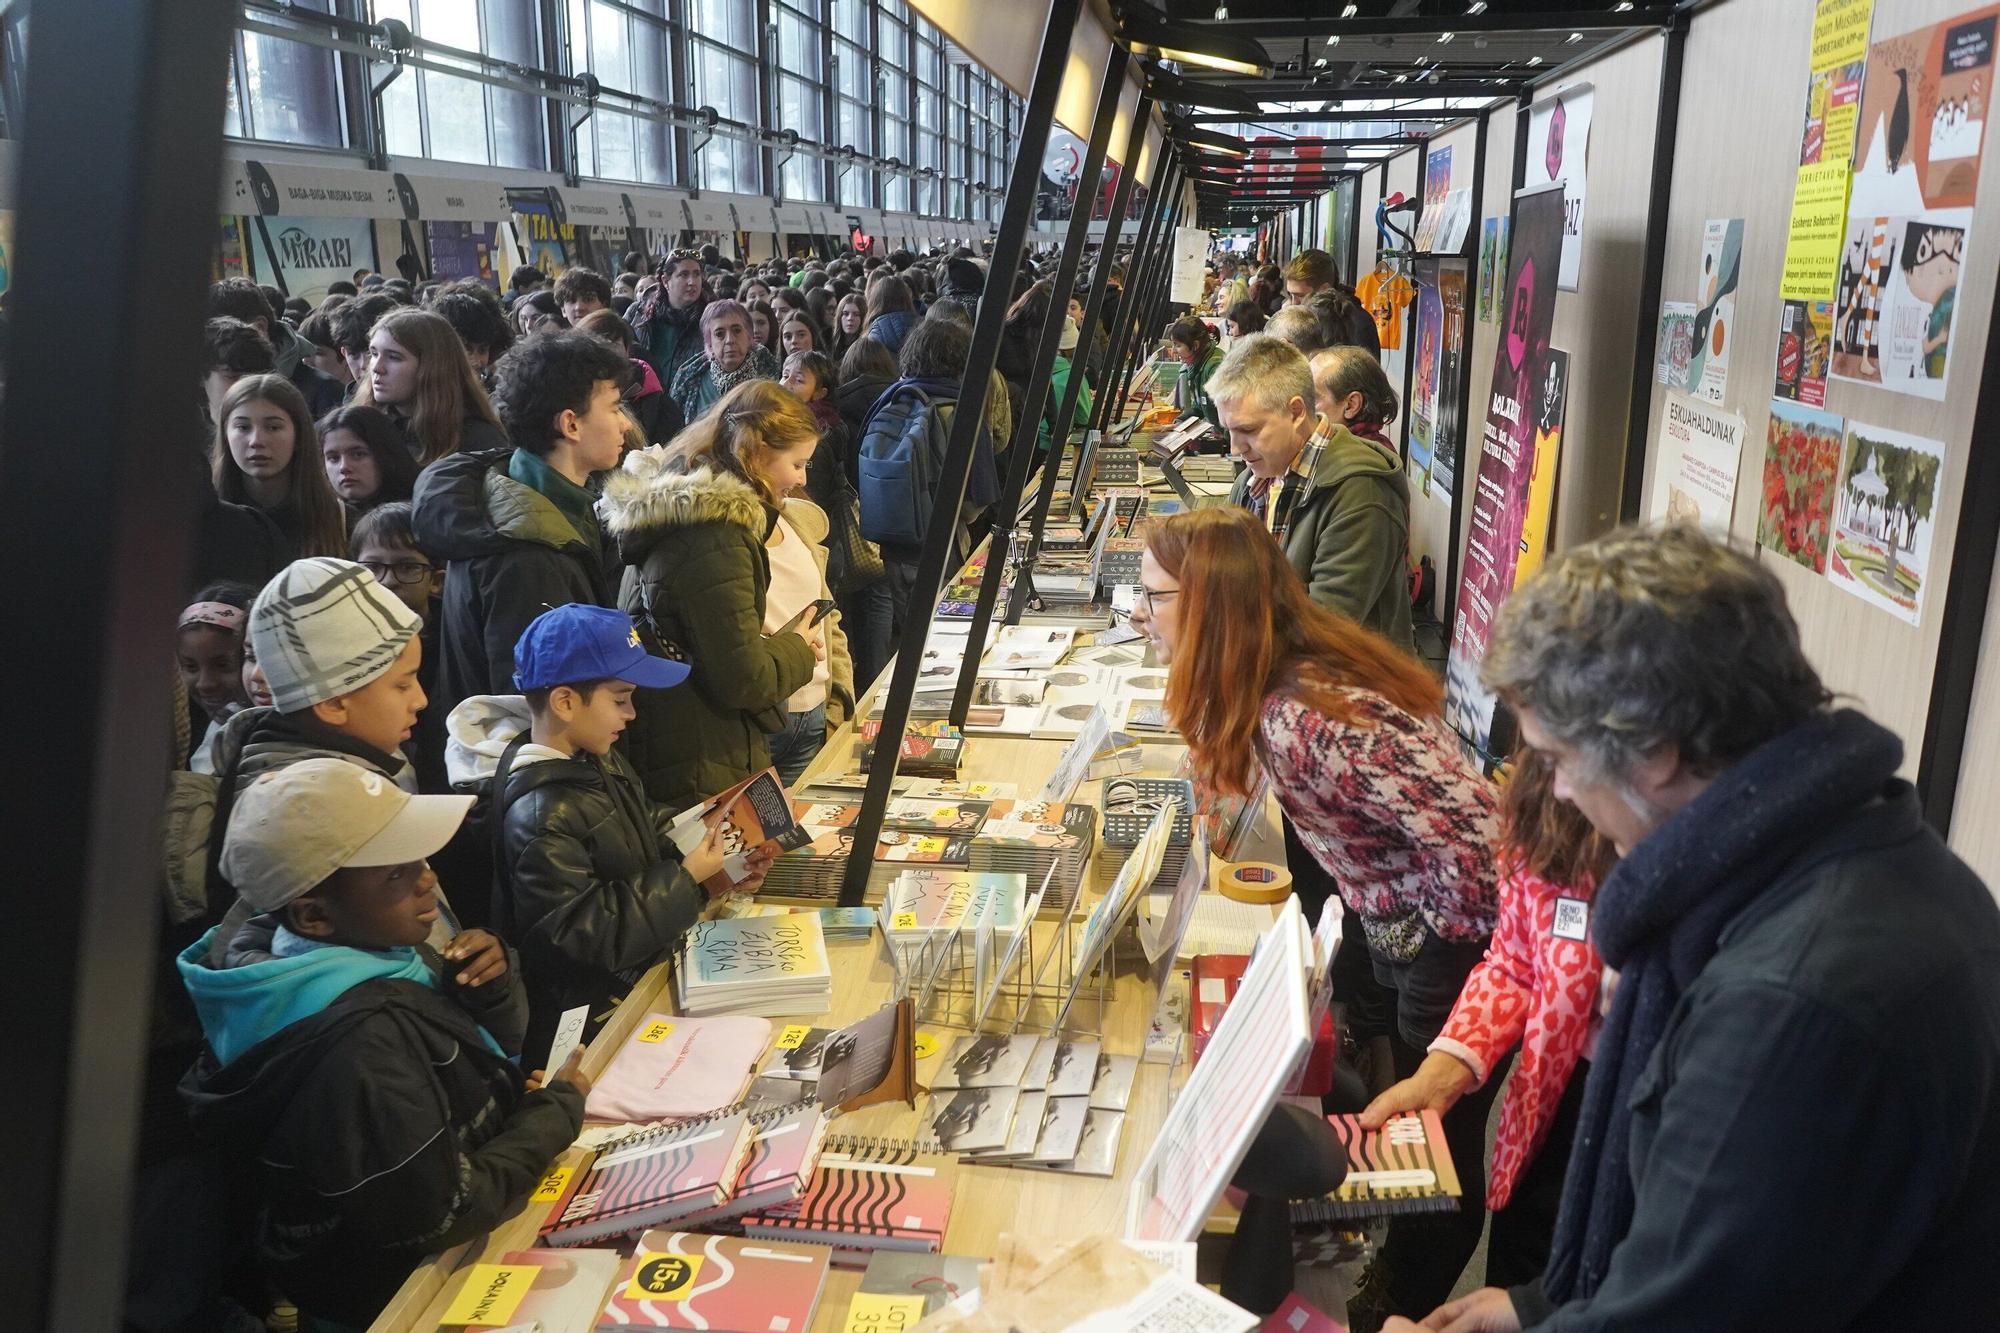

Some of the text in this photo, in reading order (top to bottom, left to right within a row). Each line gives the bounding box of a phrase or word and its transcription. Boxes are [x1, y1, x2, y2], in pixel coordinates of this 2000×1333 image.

[261, 183, 270, 198] 6
[288, 187, 326, 200] BAGA-BIGA
[279, 231, 352, 268] MIRARI
[1670, 402, 1736, 445] ESKUAHALDUNAK
[646, 1025, 668, 1039] 18€
[783, 1030, 802, 1044] 12€
[541, 1174, 564, 1194] 30€
[648, 1260, 683, 1290] 15€
[467, 1271, 513, 1321] DOHAINIK
